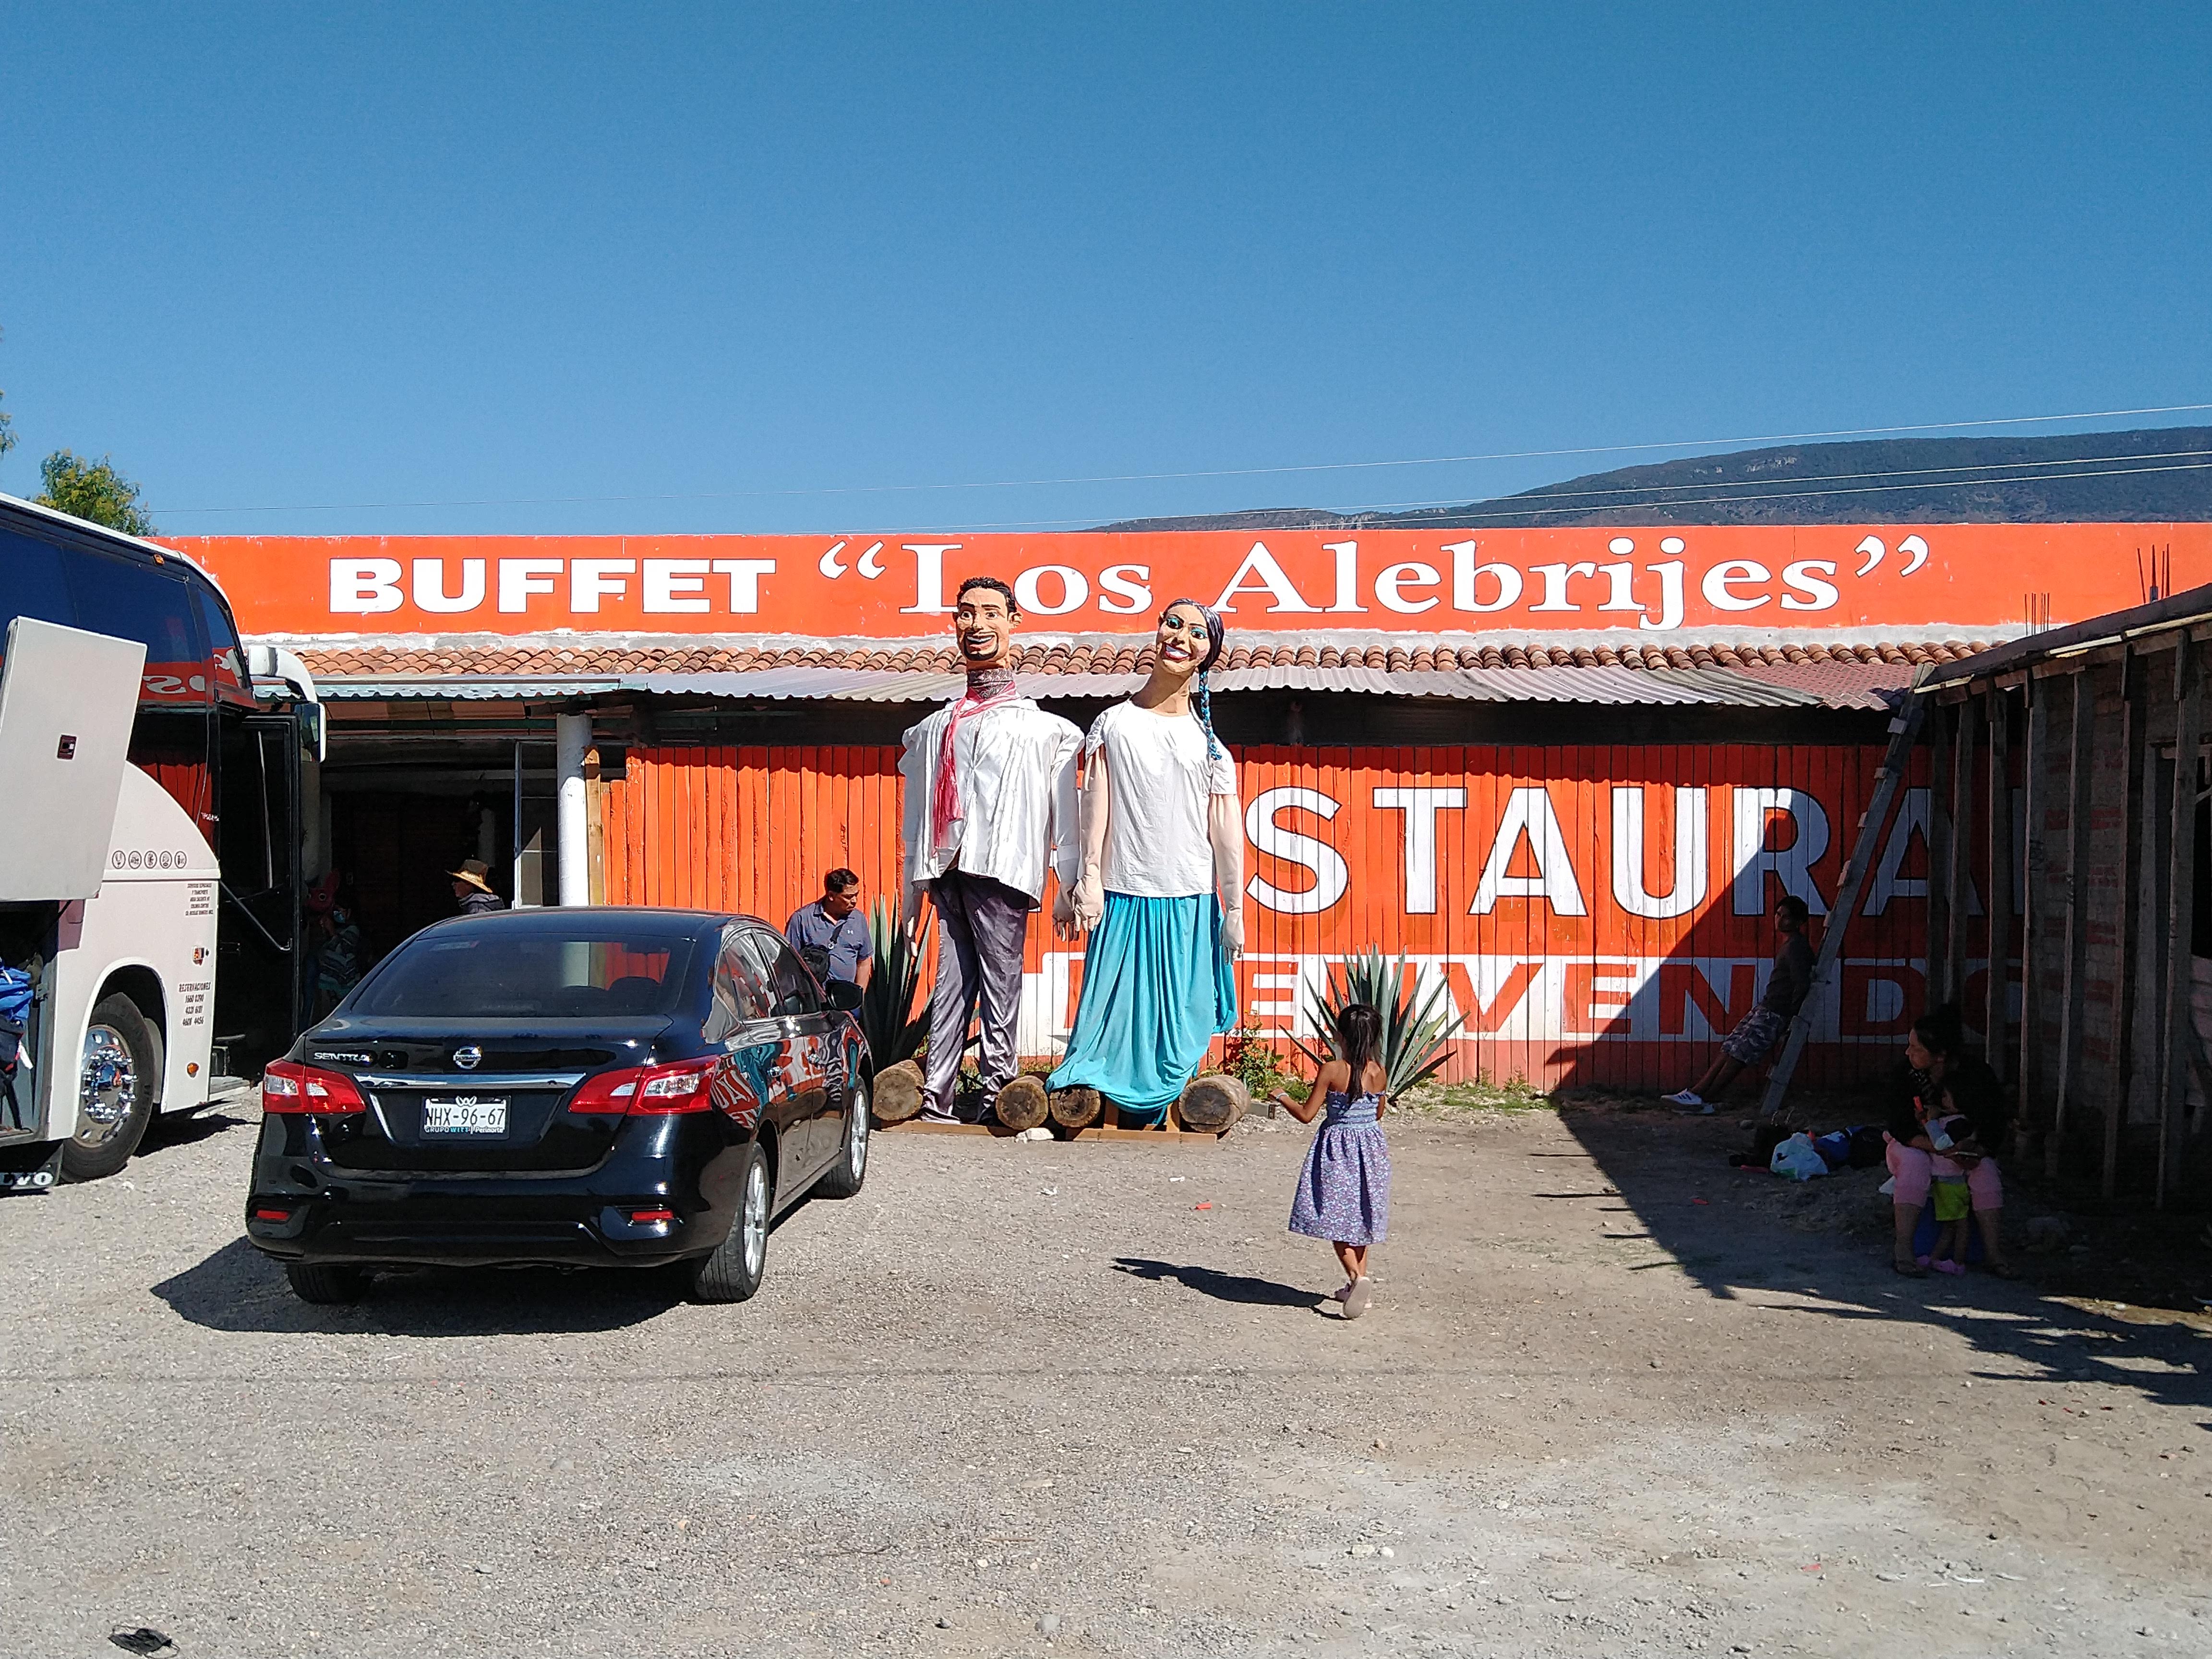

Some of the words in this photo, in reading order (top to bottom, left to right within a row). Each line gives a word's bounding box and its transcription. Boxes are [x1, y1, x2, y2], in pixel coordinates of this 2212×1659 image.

[329, 558, 776, 614] BUFFET
[1209, 534, 1929, 630] Alebrijes”
[1244, 785, 2025, 920] STAURA
[179, 982, 211, 992] RESERVACIONES
[313, 1052, 371, 1062] SENTRA
[425, 1107, 505, 1126] NHX-96-67
